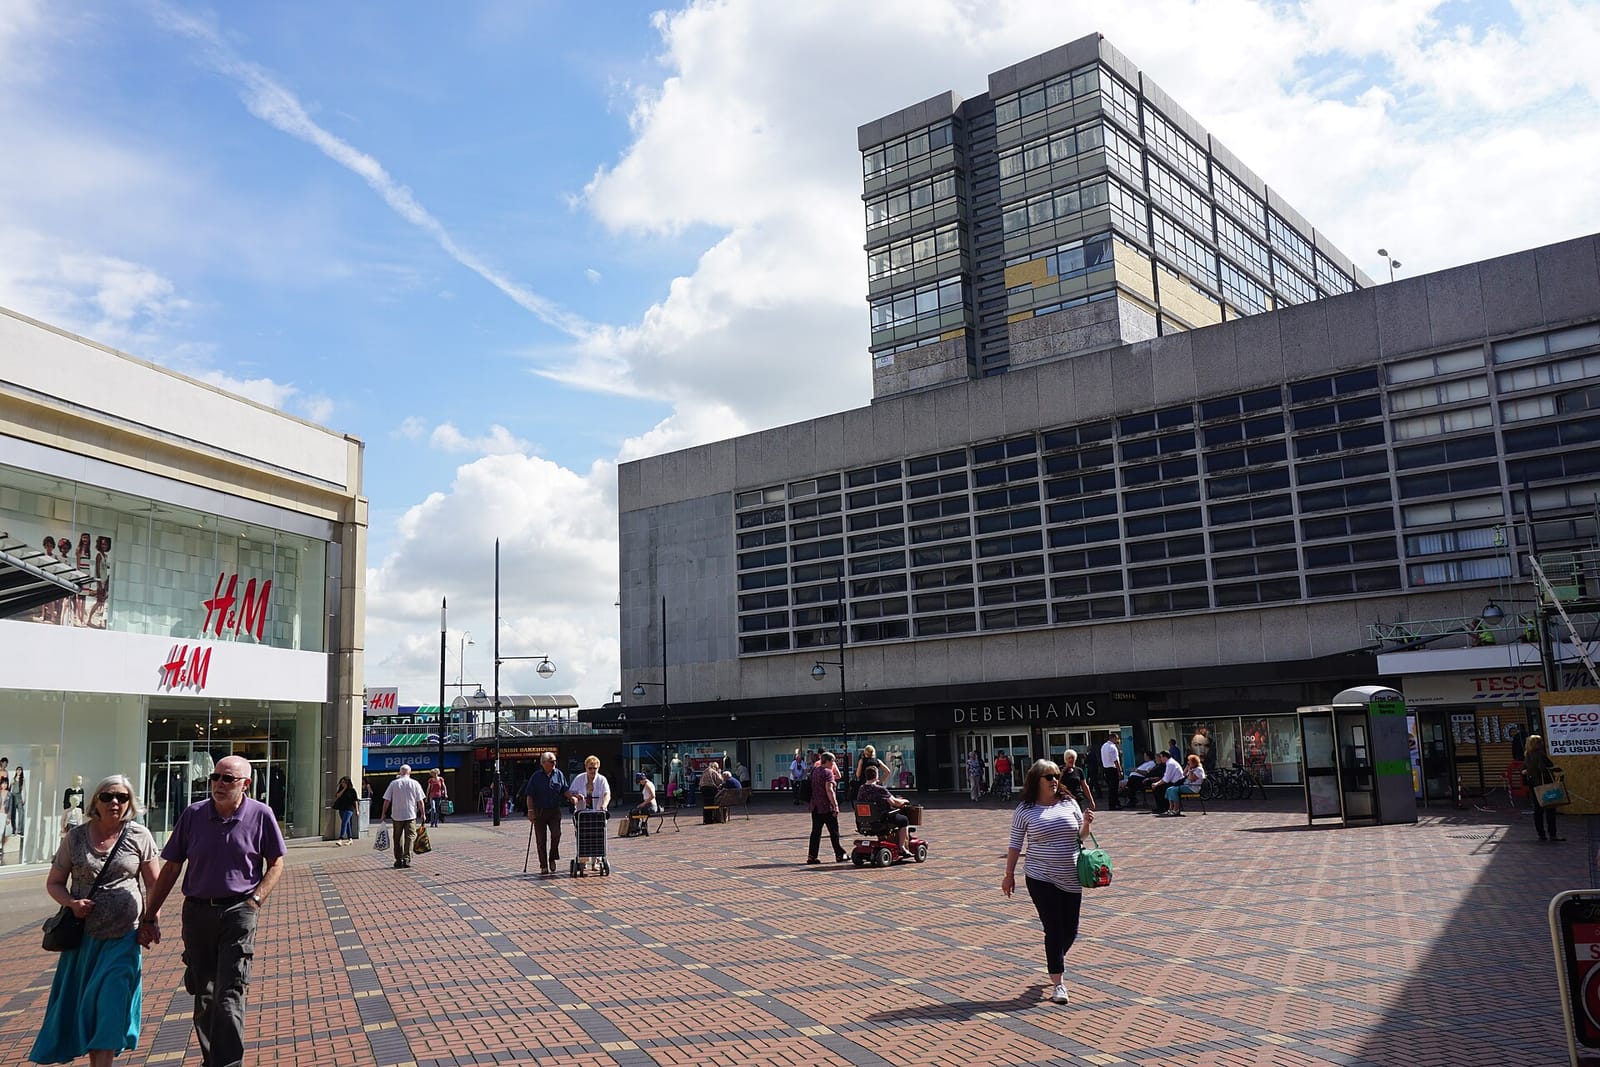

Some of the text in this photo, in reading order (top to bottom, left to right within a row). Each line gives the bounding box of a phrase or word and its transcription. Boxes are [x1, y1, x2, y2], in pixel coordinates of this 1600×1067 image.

[203, 572, 272, 641] H&M
[163, 644, 212, 690] H&M
[369, 692, 396, 710] H&M
[953, 700, 1097, 723] DEBENHAMS
[1548, 712, 1599, 723] TESCO
[385, 754, 431, 768] parade
